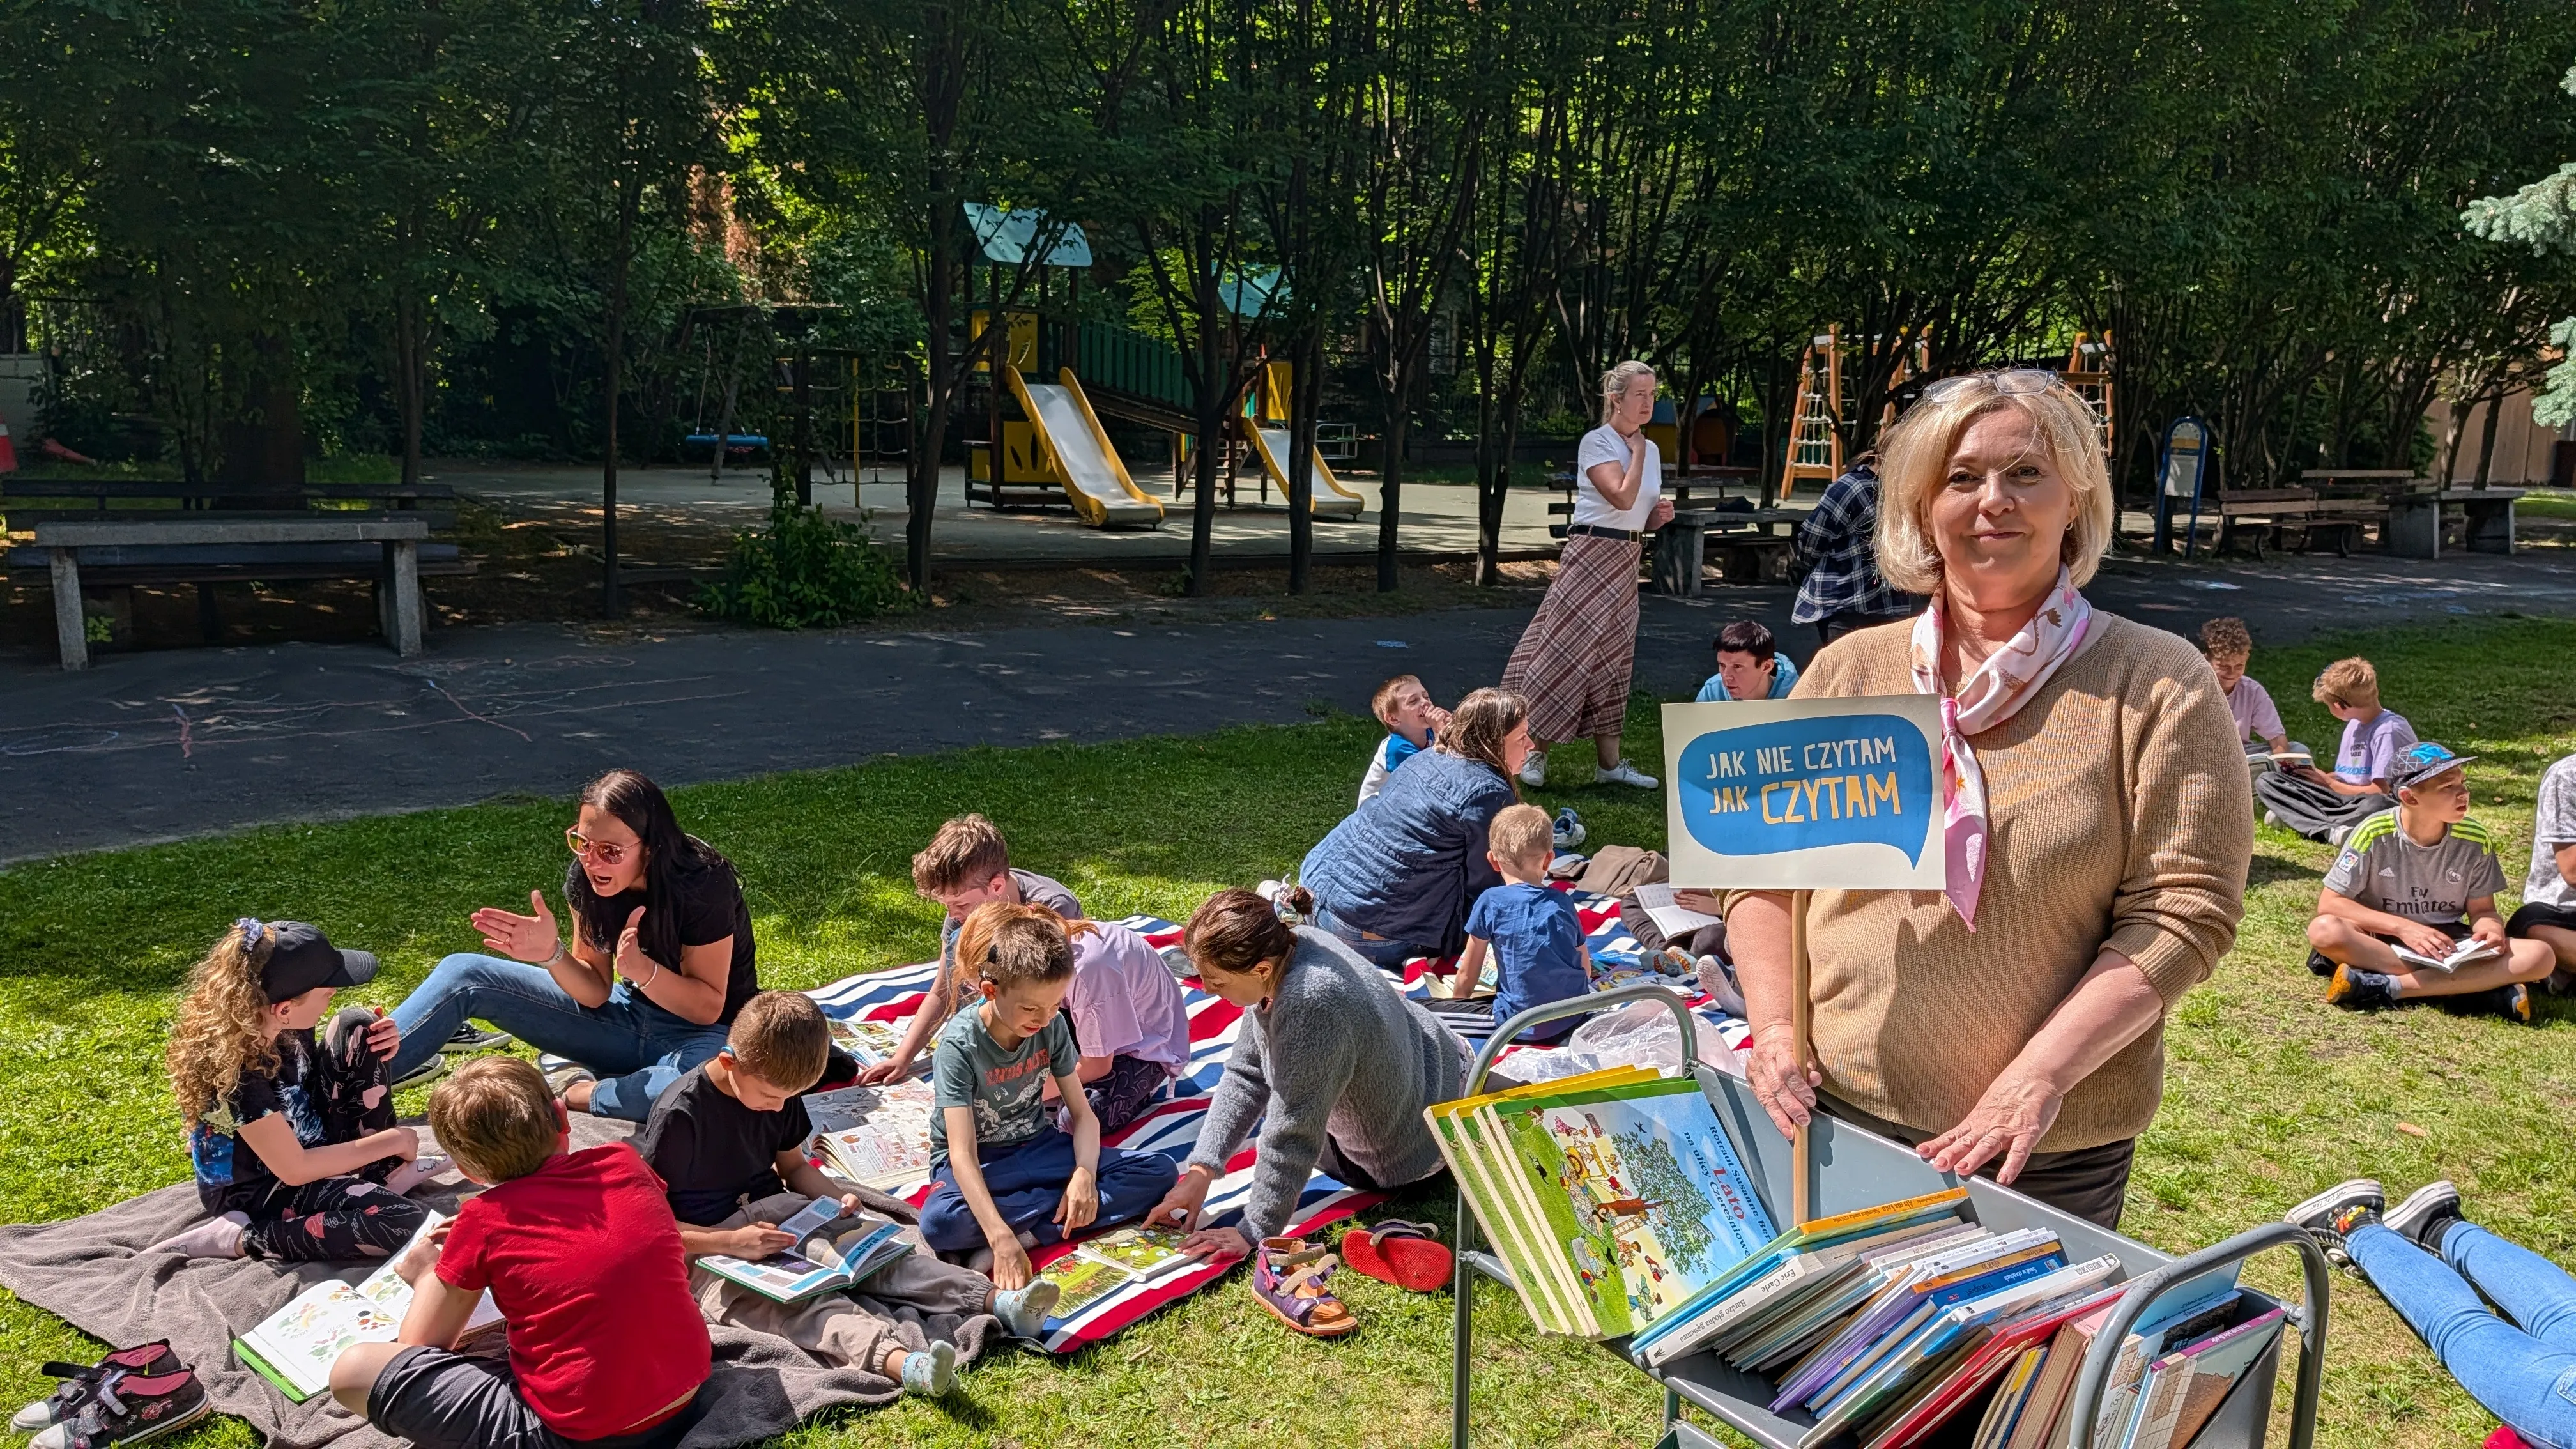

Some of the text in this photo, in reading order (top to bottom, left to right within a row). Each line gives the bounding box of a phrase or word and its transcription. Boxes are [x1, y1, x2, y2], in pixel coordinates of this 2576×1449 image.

[1706, 735, 1896, 779] JAK NIE CZYTAM
[1709, 771, 1901, 825] JAK CZYTAM
[1709, 1125, 1735, 1168] Rotraut
[1731, 1170, 1759, 1217] Susanne
[1683, 1131, 1751, 1259] na ulicy Czereśniowe
[1712, 1167, 1745, 1220] Lato
[1882, 1204, 1896, 1212] kota
[1903, 1200, 1913, 1208] Ala
[1761, 1268, 1797, 1292] Eric Carle
[1966, 1282, 1994, 1296] Transport
[1679, 1298, 1747, 1342] Bardzo głodna gąsienica
